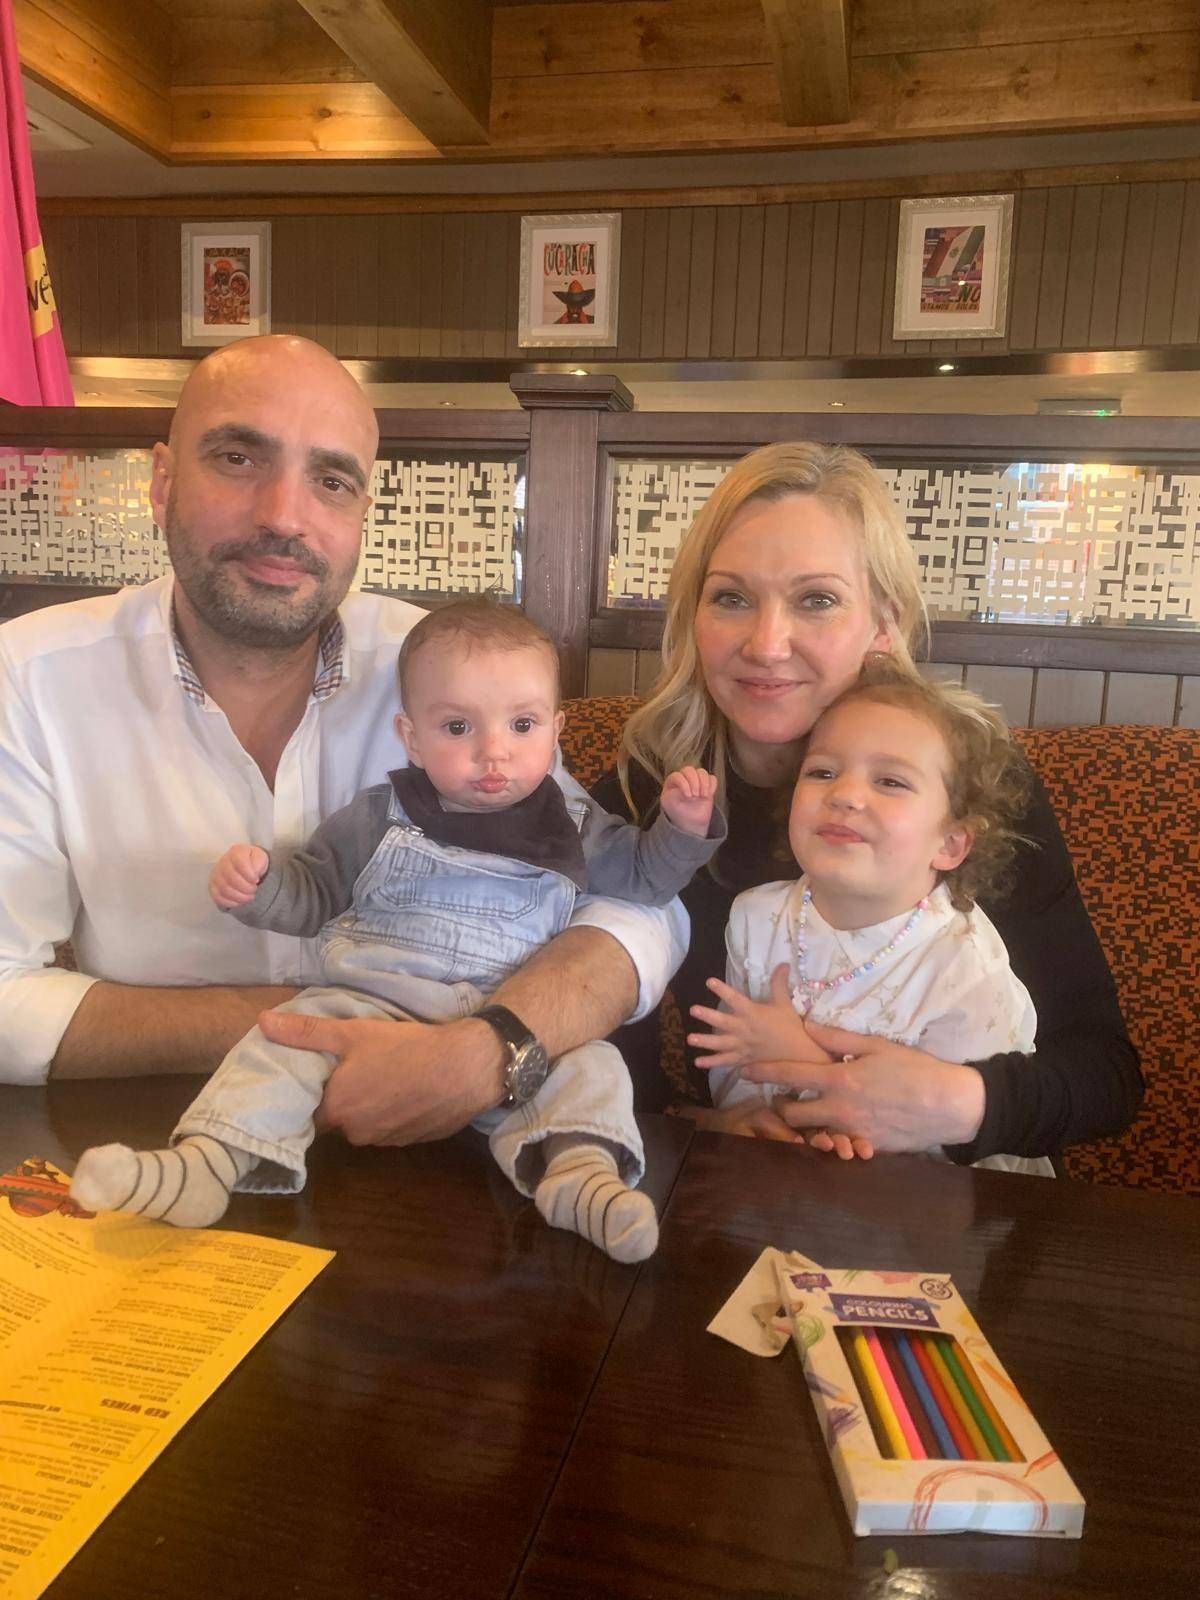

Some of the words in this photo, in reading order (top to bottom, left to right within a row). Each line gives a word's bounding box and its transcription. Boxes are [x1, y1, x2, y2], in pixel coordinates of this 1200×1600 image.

[544, 241, 596, 276] CUCARACHA
[846, 1298, 914, 1310] COLOURING
[842, 1304, 929, 1321] PENCILS
[100, 1399, 143, 1415] WINES
[145, 1406, 171, 1419] RED
